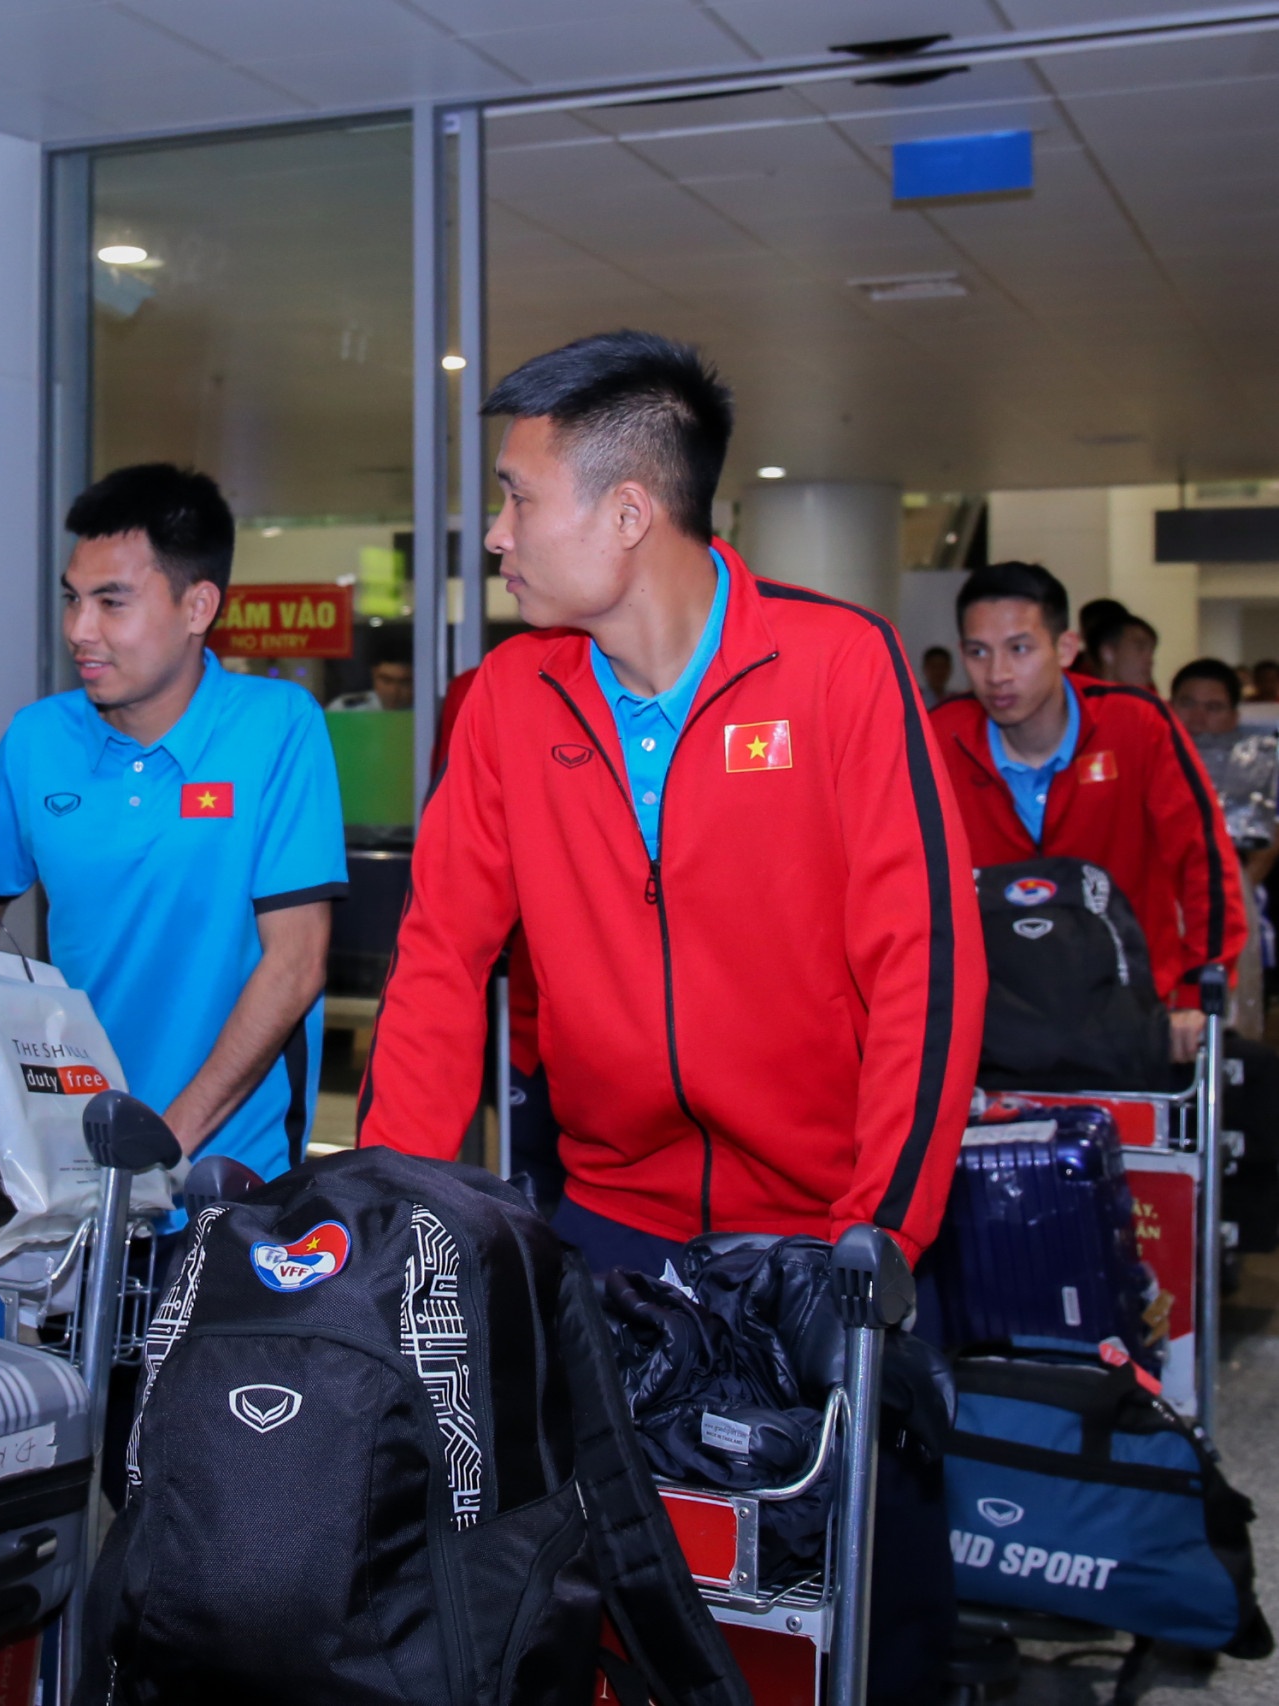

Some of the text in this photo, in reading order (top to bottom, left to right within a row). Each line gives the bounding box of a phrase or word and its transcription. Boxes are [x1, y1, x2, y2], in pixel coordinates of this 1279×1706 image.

[279, 595, 336, 629] VÀO
[231, 633, 309, 649] NO ENTRY
[11, 1038, 40, 1057] THE
[27, 1069, 103, 1092] duty free
[280, 1265, 309, 1277] VFF
[998, 1542, 1118, 1590] SPORT
